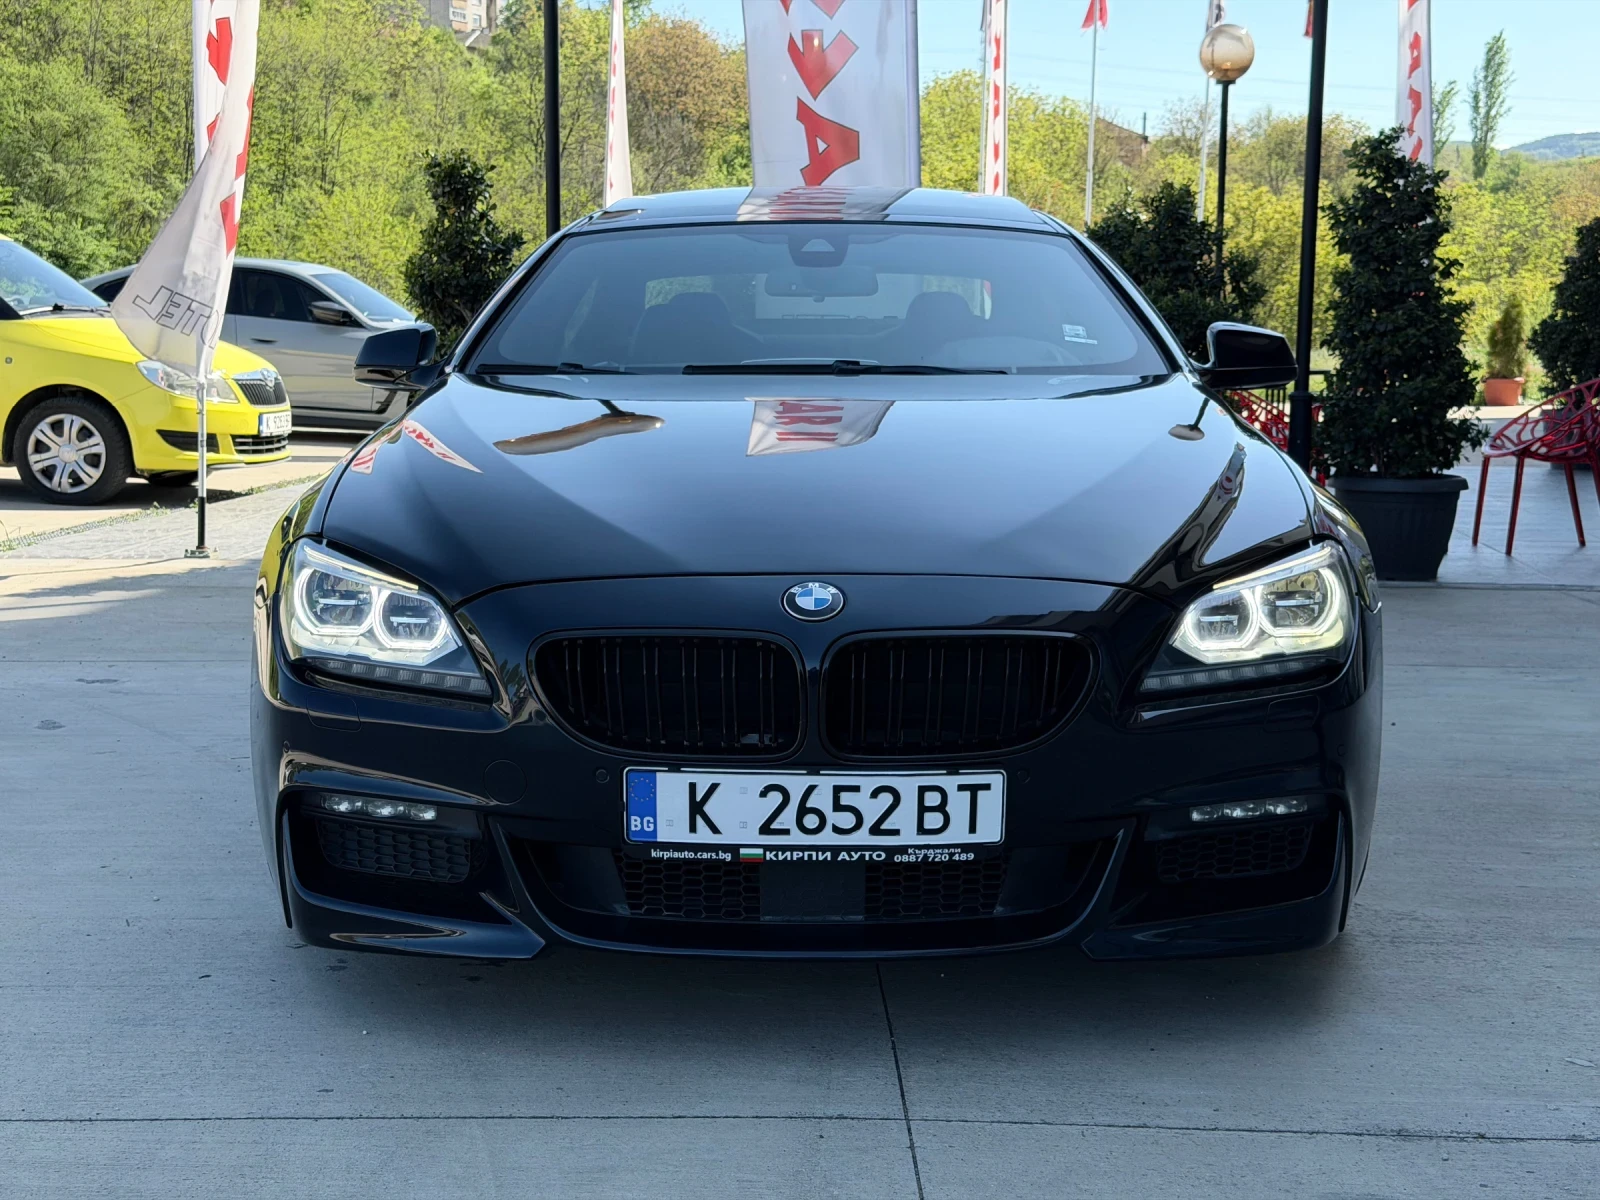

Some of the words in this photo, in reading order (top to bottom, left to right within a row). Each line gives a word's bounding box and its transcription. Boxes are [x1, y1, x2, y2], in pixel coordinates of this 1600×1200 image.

[790, 583, 839, 594] BMW
[688, 781, 723, 835] K
[630, 815, 655, 832] BG
[650, 848, 732, 862] kirpiauto.cars.bg
[765, 851, 832, 861] КИРПИ
[837, 851, 887, 861] АУТО
[893, 853, 924, 863] 0887
[927, 853, 950, 862] 720
[951, 852, 975, 861] 489
